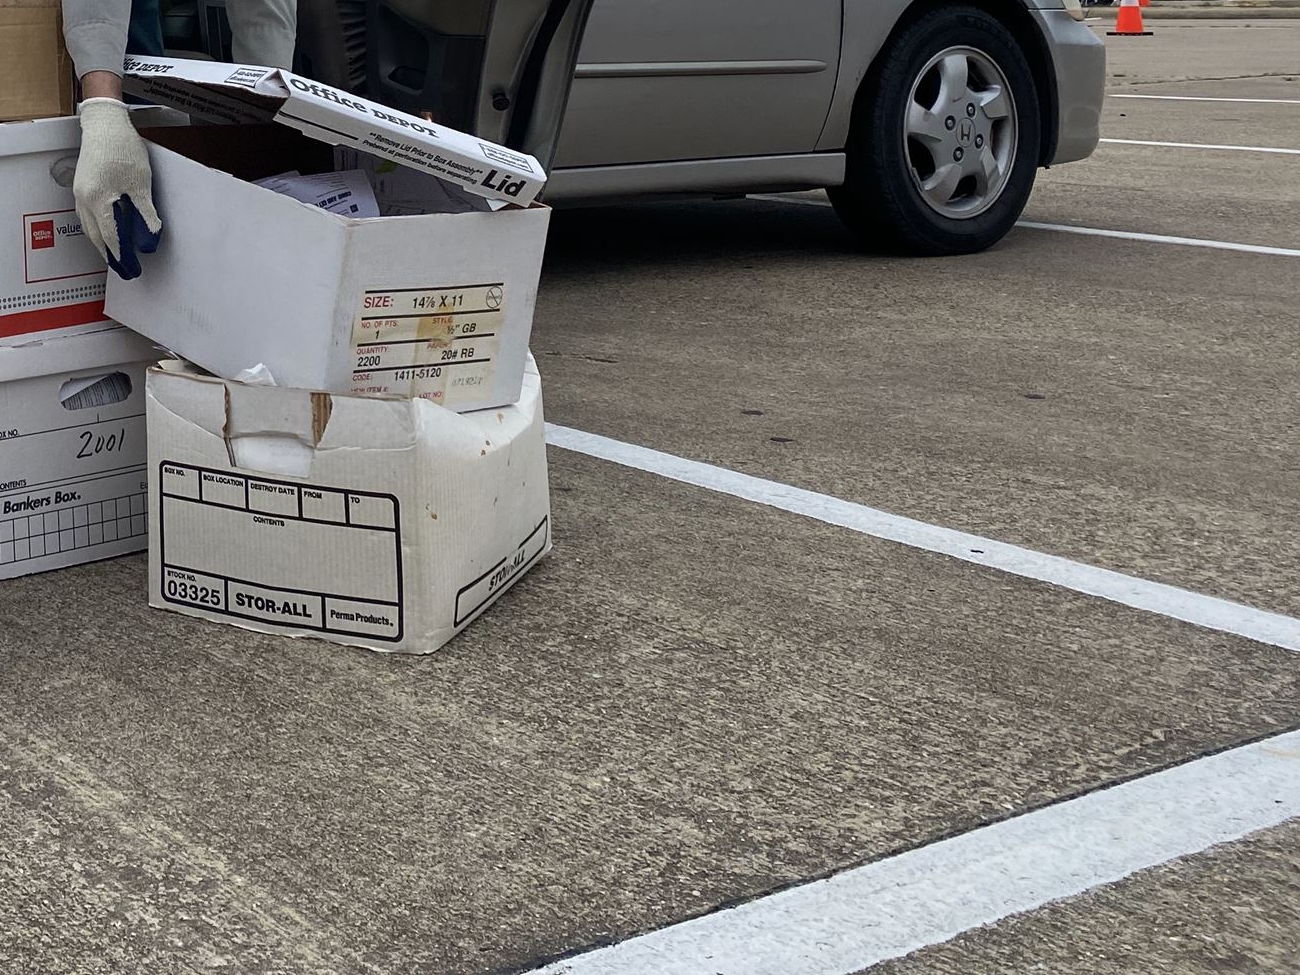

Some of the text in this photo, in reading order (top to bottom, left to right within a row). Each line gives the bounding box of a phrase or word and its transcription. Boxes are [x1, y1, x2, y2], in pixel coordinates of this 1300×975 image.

[140, 64, 174, 73] DEPOT
[290, 78, 440, 138] Office DEPOT
[362, 140, 388, 152] Prebend
[394, 151, 427, 166] perforation
[427, 161, 446, 173] before
[400, 143, 410, 151] Lid
[410, 146, 426, 158] Prior
[435, 155, 446, 165] Box
[480, 169, 526, 197] Lid
[364, 296, 394, 308] SIZE:
[439, 295, 448, 307] X
[452, 294, 463, 306] 11
[376, 330, 379, 339] 1
[462, 323, 476, 333] GB
[441, 348, 474, 360] 20# RB
[358, 356, 380, 367] 2200
[394, 367, 442, 381] 1411-5120
[76, 428, 125, 459] 2001
[164, 467, 175, 475] BOX
[203, 474, 244, 488] BOX LOCATION
[250, 482, 295, 496] DESTROY DATE
[304, 491, 322, 500] FROM
[3, 496, 51, 514] Bankers
[253, 515, 285, 527] CONTENTS
[167, 570, 185, 580] STOCK
[167, 579, 221, 606] 03325
[235, 592, 312, 618] STOR-ALL
[330, 610, 354, 622] Perma
